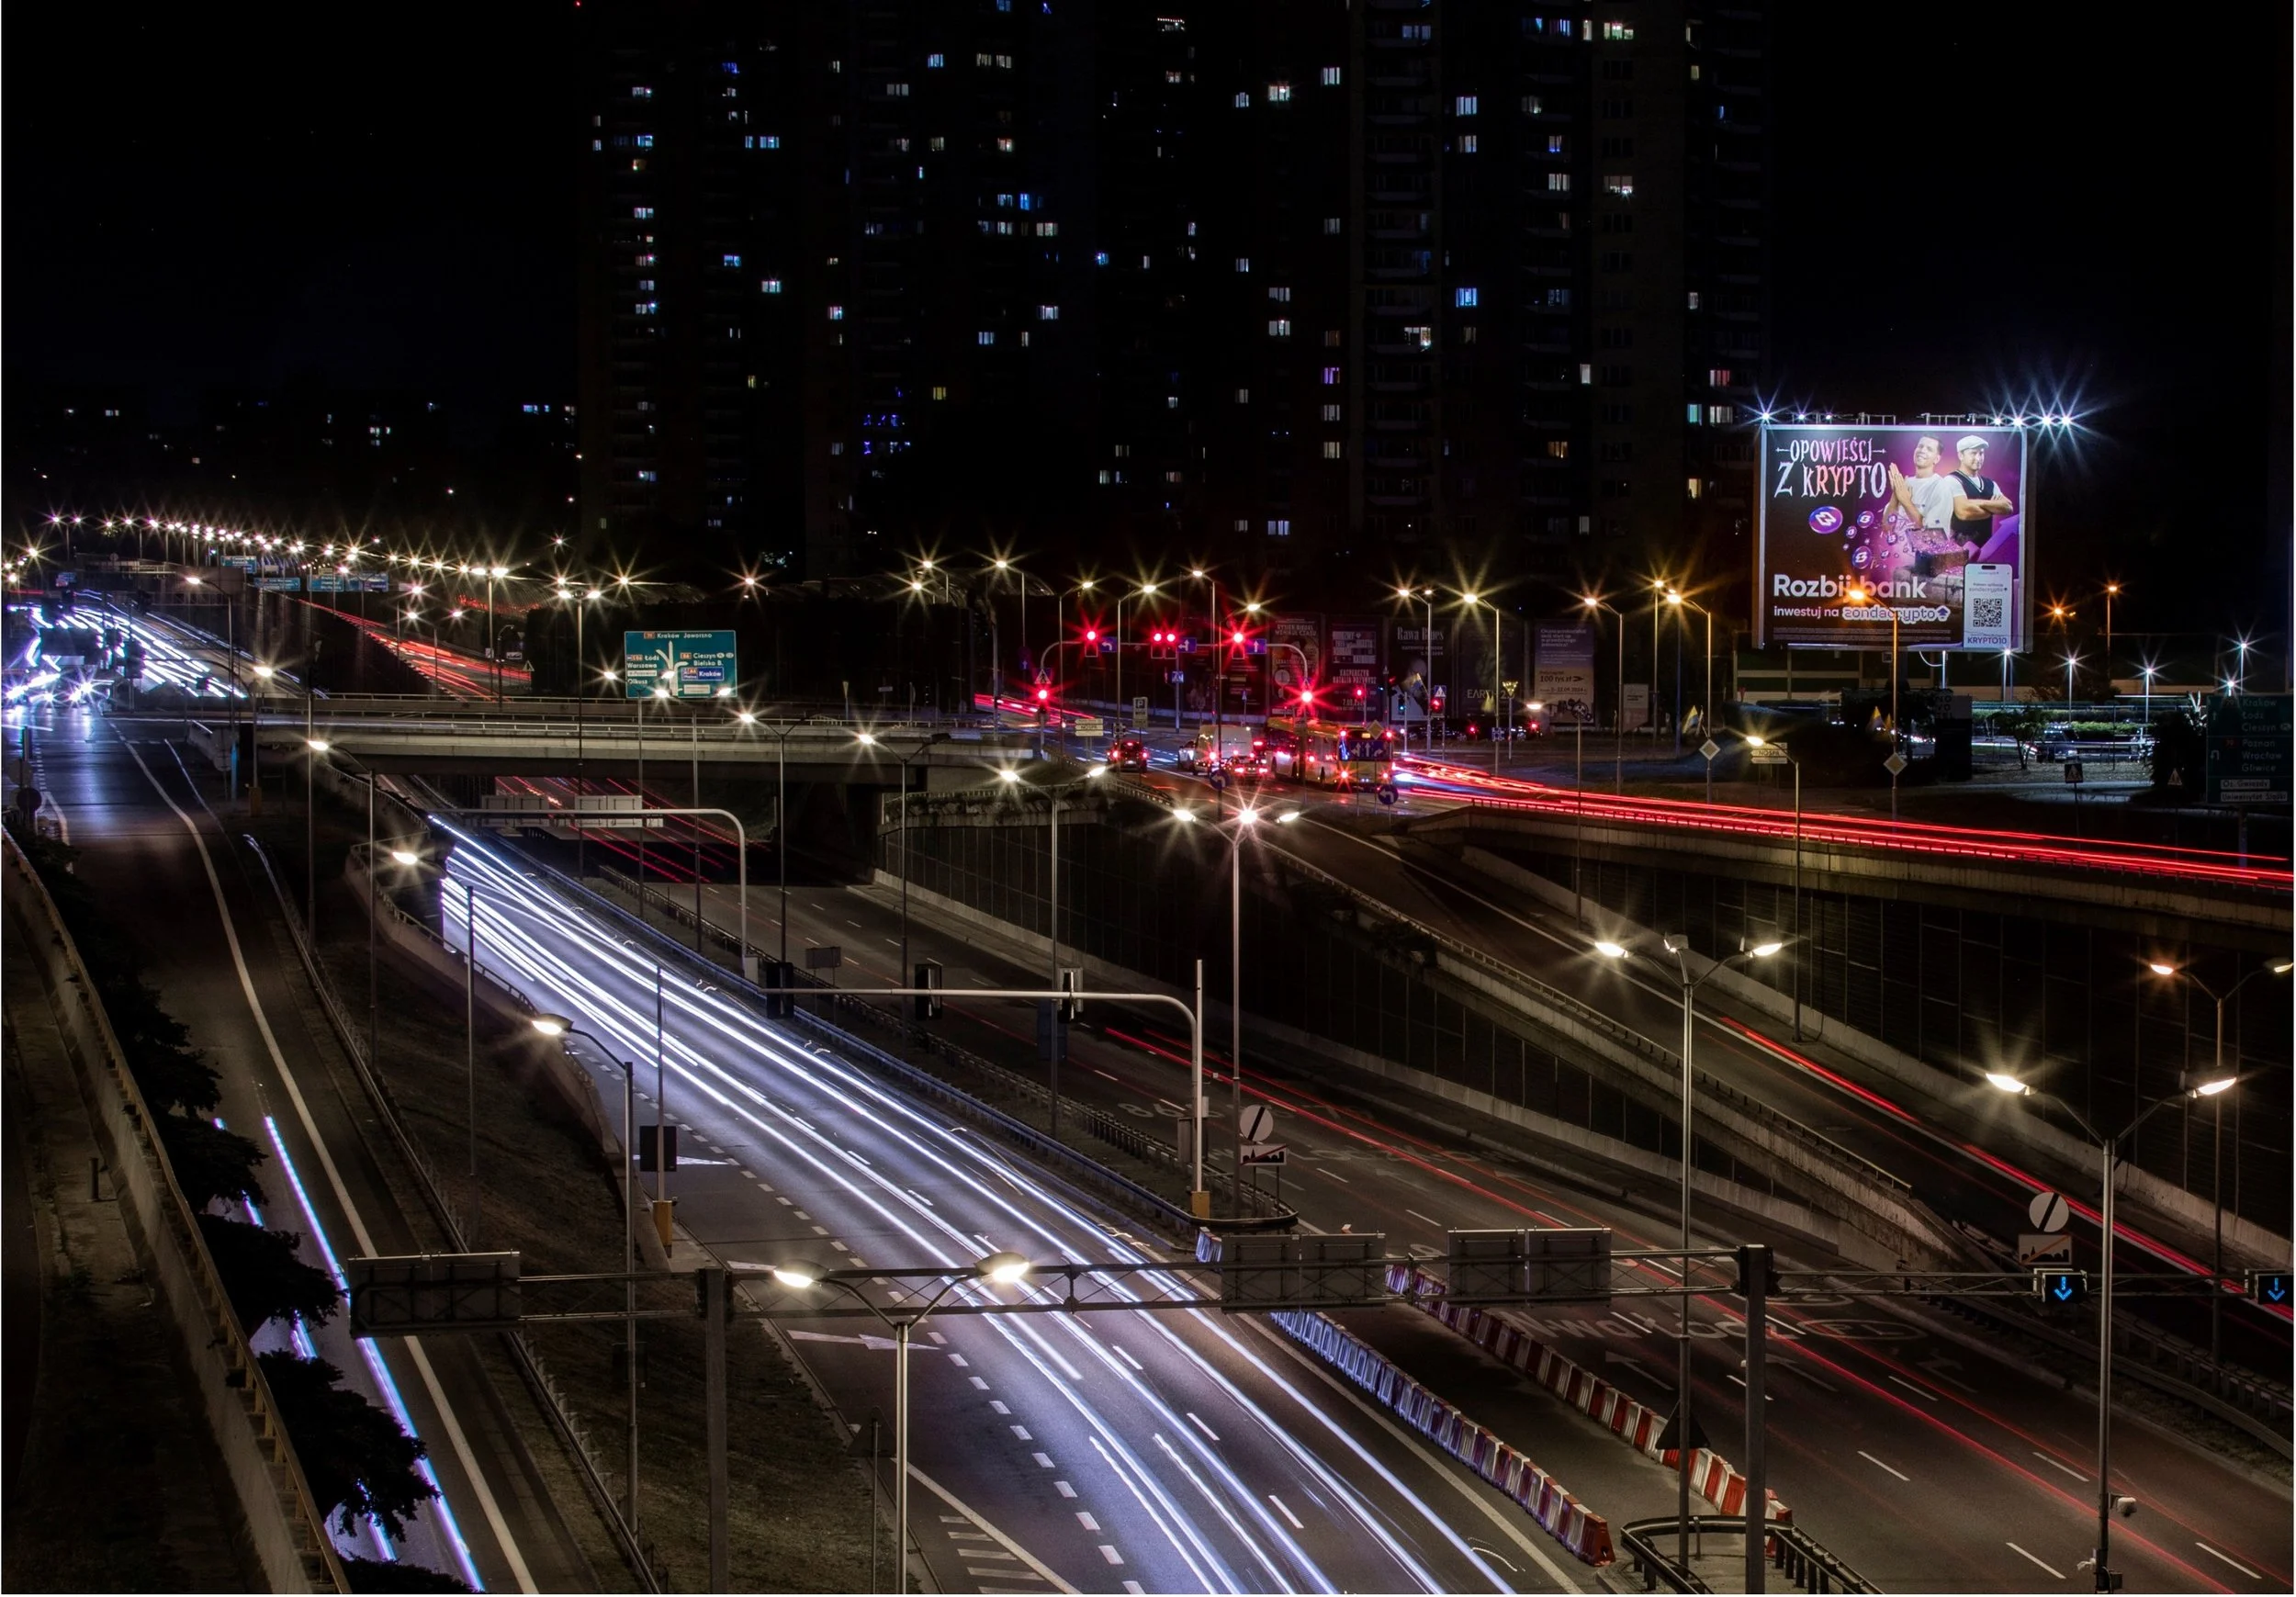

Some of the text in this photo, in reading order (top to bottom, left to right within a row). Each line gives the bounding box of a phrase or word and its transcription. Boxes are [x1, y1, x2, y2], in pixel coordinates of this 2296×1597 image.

[1790, 437, 1873, 464] OPOWIEŚCI
[1774, 461, 1887, 499] Z KRYPTO
[1774, 574, 1928, 602] Rozbij bank
[1773, 606, 1821, 619] inwestuj
[1397, 626, 1420, 641] Rawa
[1967, 636, 2007, 645] KRYPTO10
[2241, 722, 2277, 733] Cieszyn
[2242, 750, 2282, 760] Wrocław
